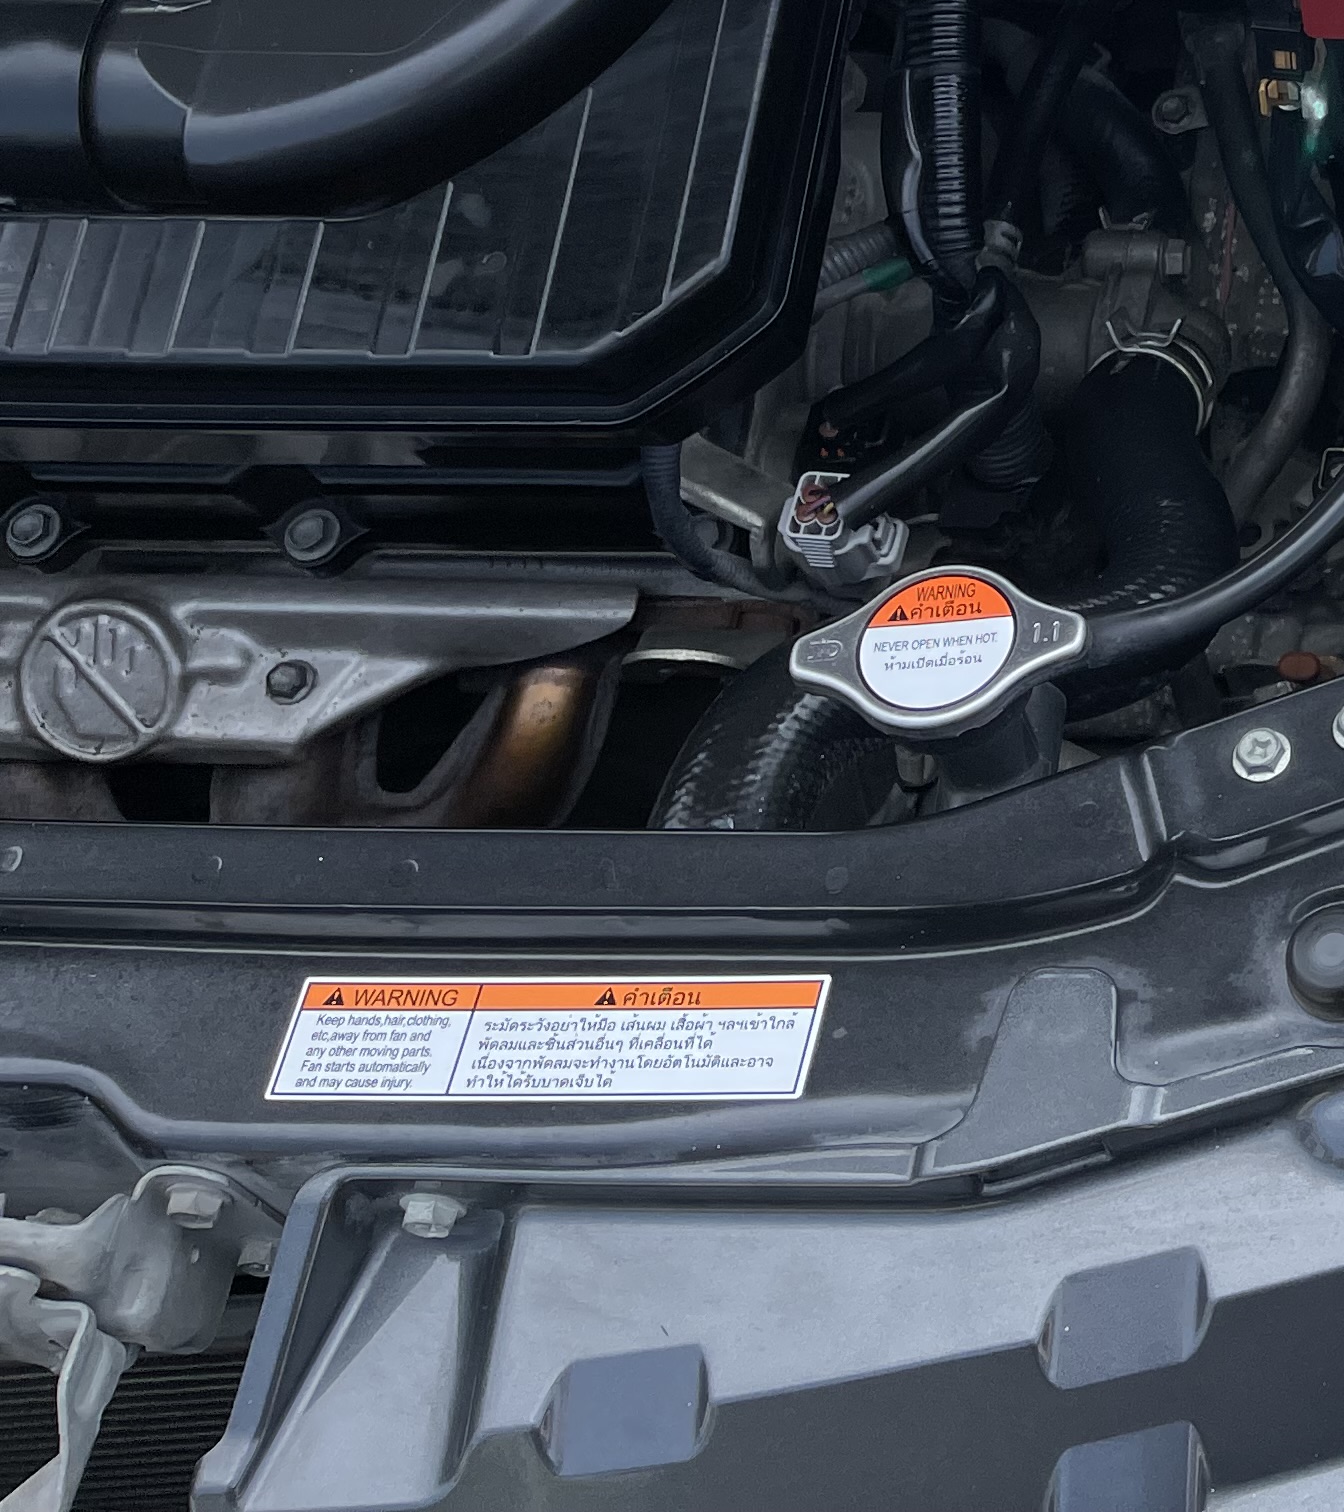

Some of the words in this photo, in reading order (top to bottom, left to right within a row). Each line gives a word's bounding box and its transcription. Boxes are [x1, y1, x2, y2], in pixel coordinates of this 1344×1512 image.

[916, 583, 976, 602] WARNING
[910, 600, 982, 620] คำเตือน
[1032, 620, 1061, 644] 1.1
[874, 641, 908, 652] NEVER
[911, 638, 940, 650] OPEN
[942, 635, 974, 648] WHEN
[884, 650, 982, 672] ห้ามเปิดเมื่อร้อน
[354, 989, 460, 1006] WARNING
[622, 986, 702, 1006] คำเตือน
[316, 1014, 345, 1028] Keep
[362, 1030, 388, 1041] from
[389, 1030, 406, 1041] fan
[409, 1030, 432, 1042] and
[305, 1048, 326, 1060] any
[328, 1046, 358, 1057] other
[359, 1046, 399, 1060] moving
[400, 1046, 432, 1060] parts.
[300, 1060, 322, 1072] Fan
[324, 1061, 355, 1073] starts
[358, 1060, 432, 1075] automatically
[294, 1077, 317, 1088] and
[319, 1078, 342, 1091] may
[344, 1078, 378, 1088] cause
[380, 1076, 413, 1091] injury.
